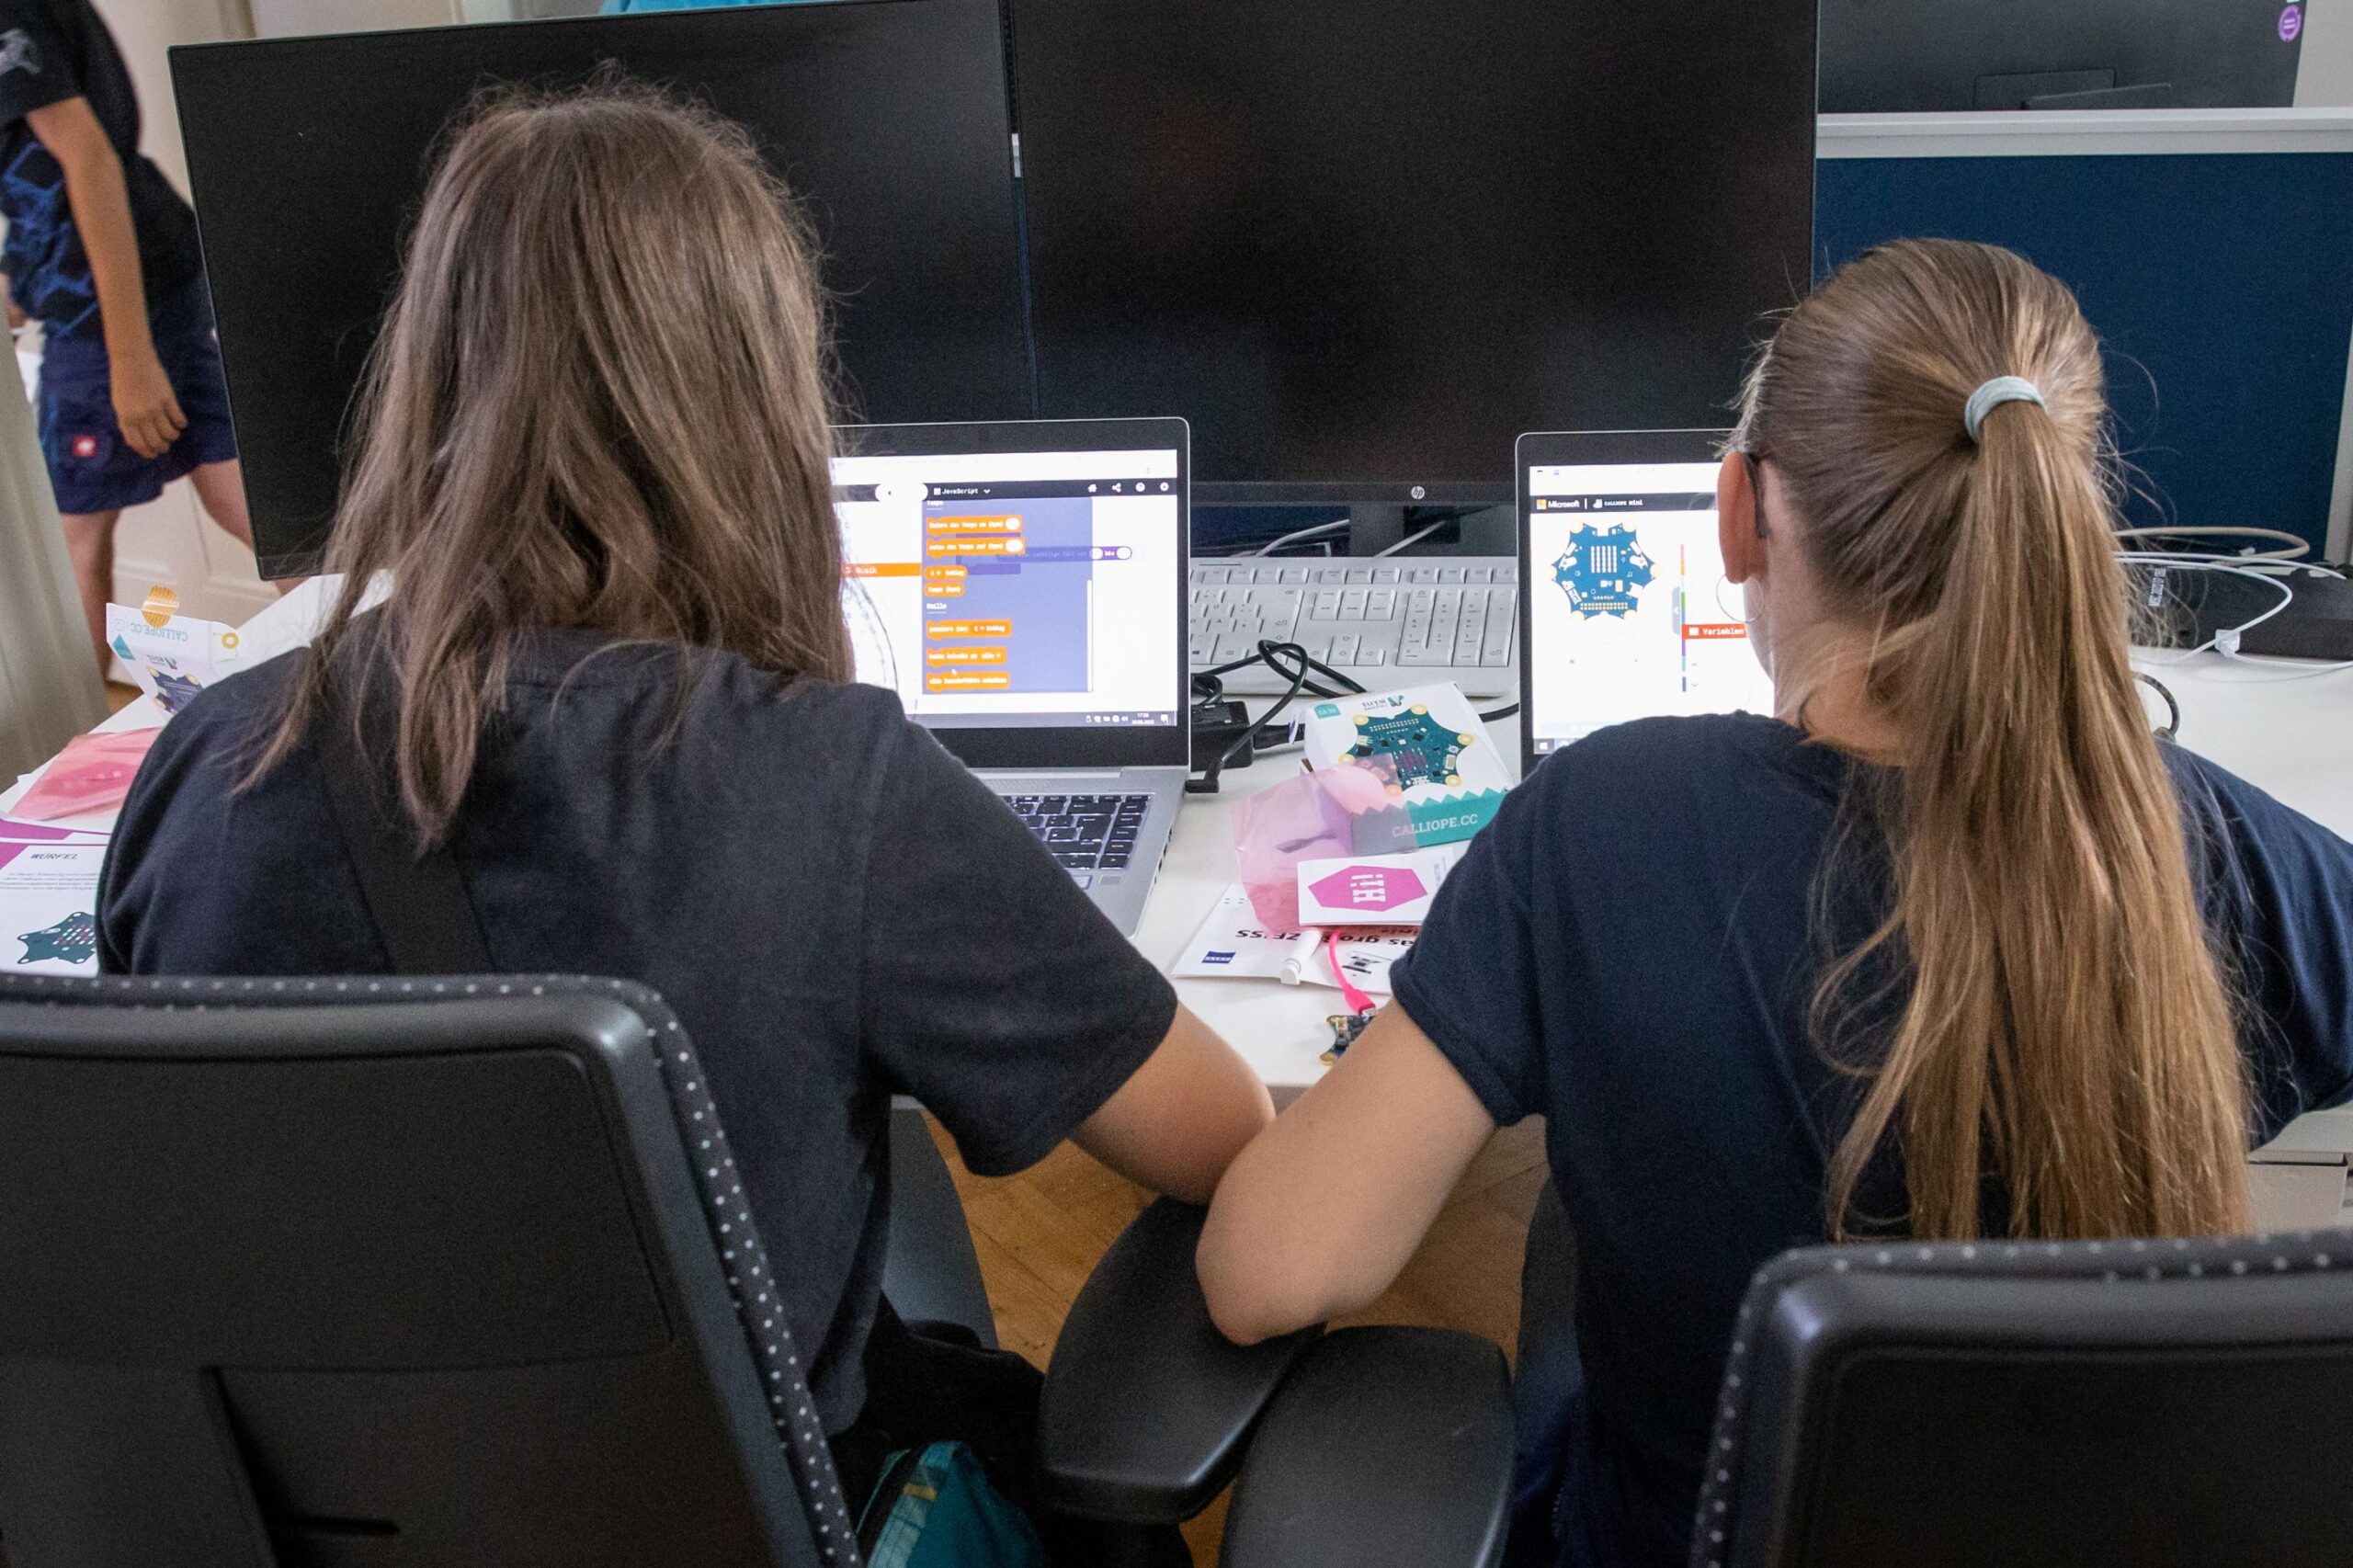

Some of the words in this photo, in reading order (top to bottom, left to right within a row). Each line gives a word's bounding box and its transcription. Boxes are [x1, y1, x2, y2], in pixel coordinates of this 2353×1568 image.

[1412, 485, 1425, 499] hp
[1548, 500, 1580, 508] Microsoft
[1702, 627, 1744, 635] Variablen
[1392, 813, 1478, 837] CALLIOPE.CC
[30, 852, 79, 860] WÜRFEL
